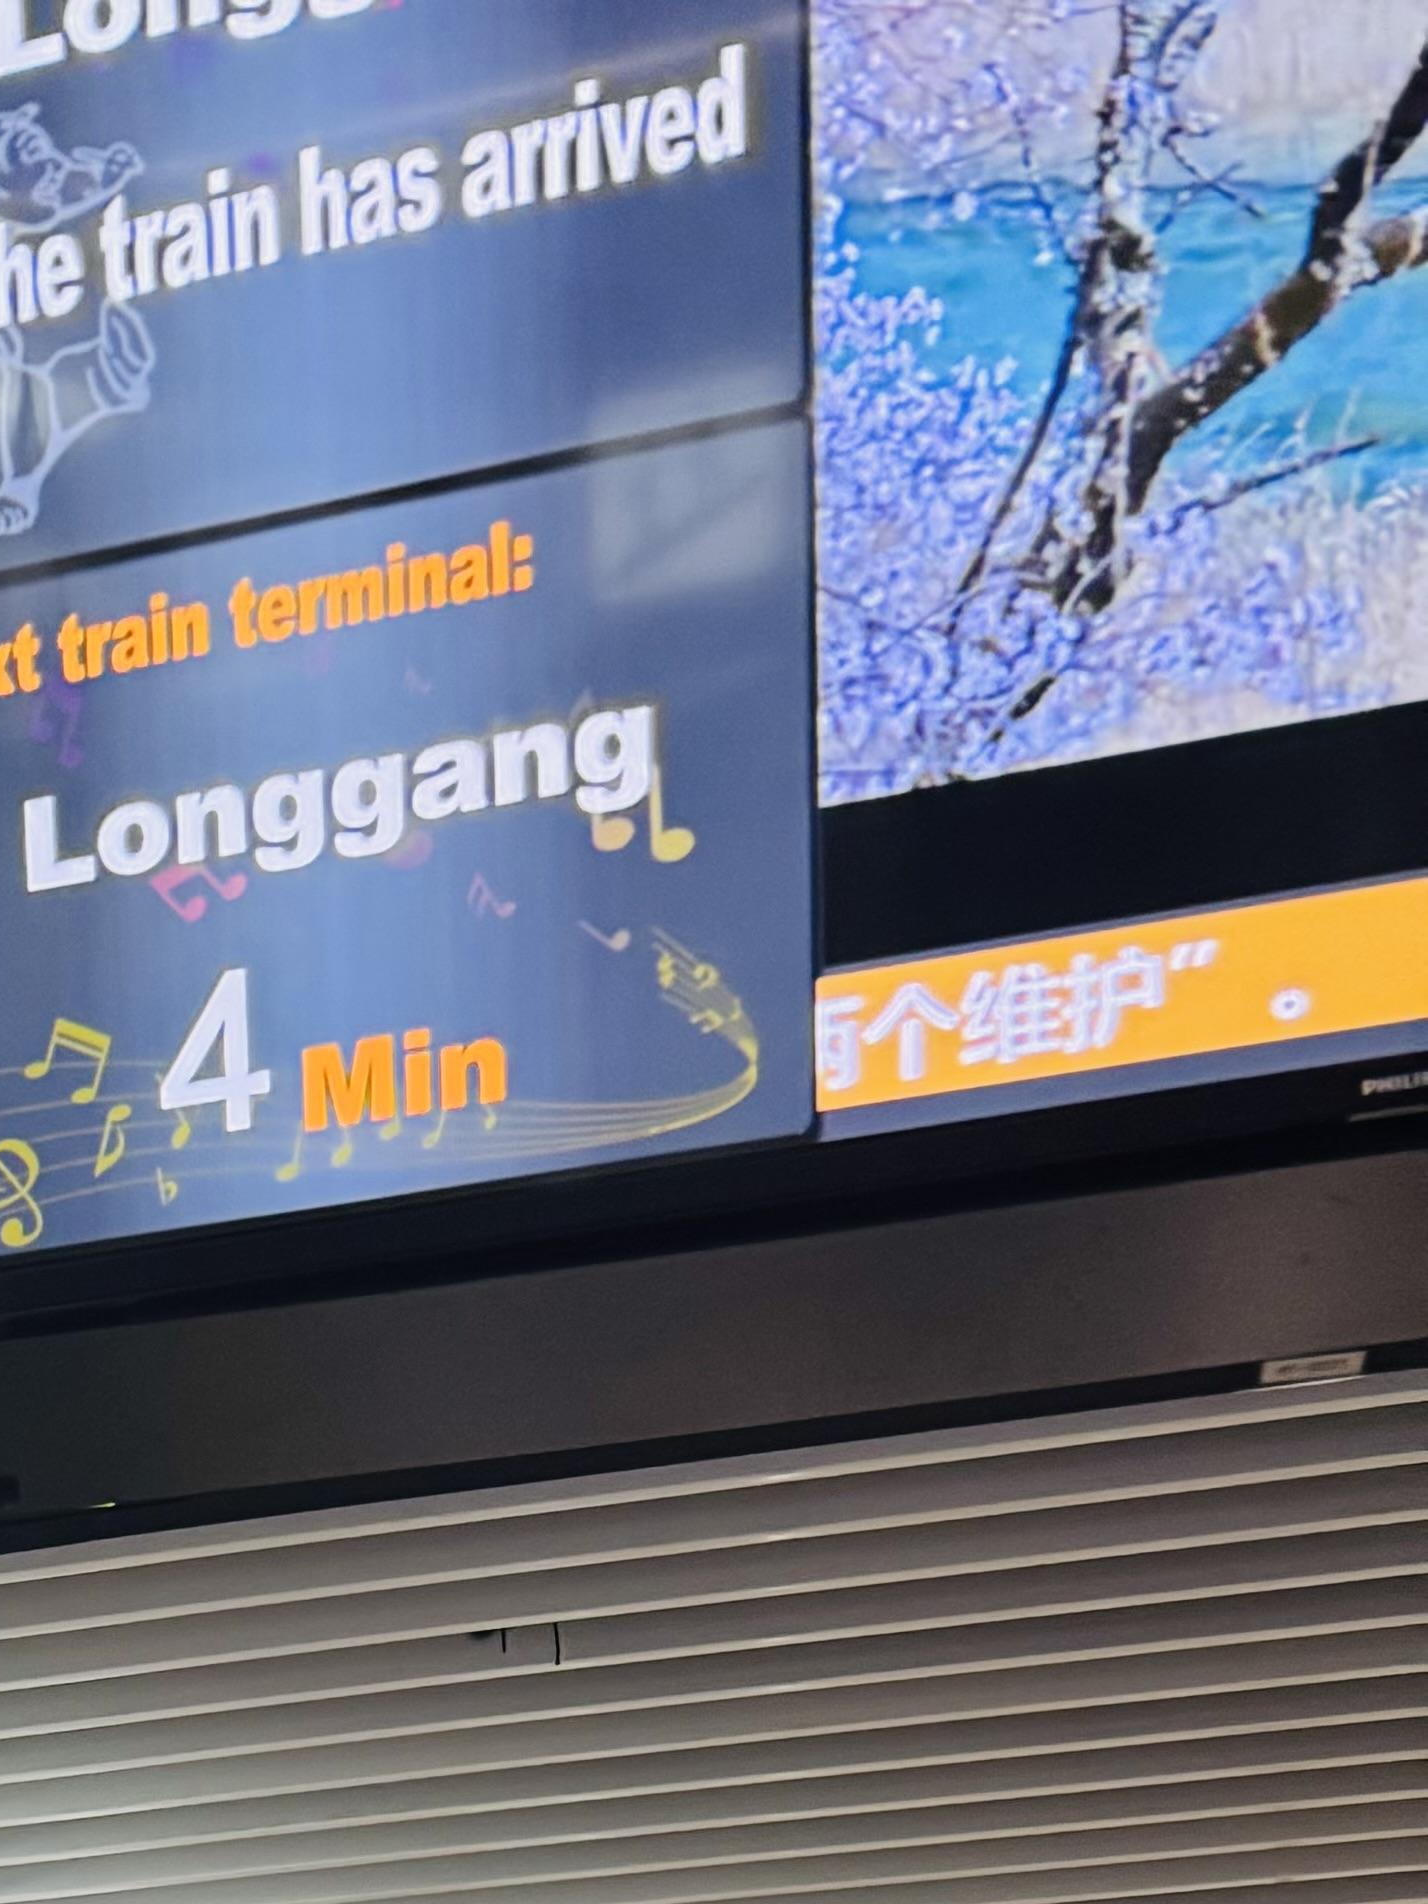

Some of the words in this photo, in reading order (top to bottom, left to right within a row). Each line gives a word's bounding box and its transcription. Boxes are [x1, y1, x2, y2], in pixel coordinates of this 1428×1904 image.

[99, 167, 281, 302] train
[298, 144, 442, 257] has
[460, 42, 748, 219] arrived
[58, 591, 212, 684] train
[228, 520, 535, 649] terminal:
[22, 704, 655, 894] Longgang
[158, 967, 272, 1134] 4
[300, 1027, 509, 1133] Min
